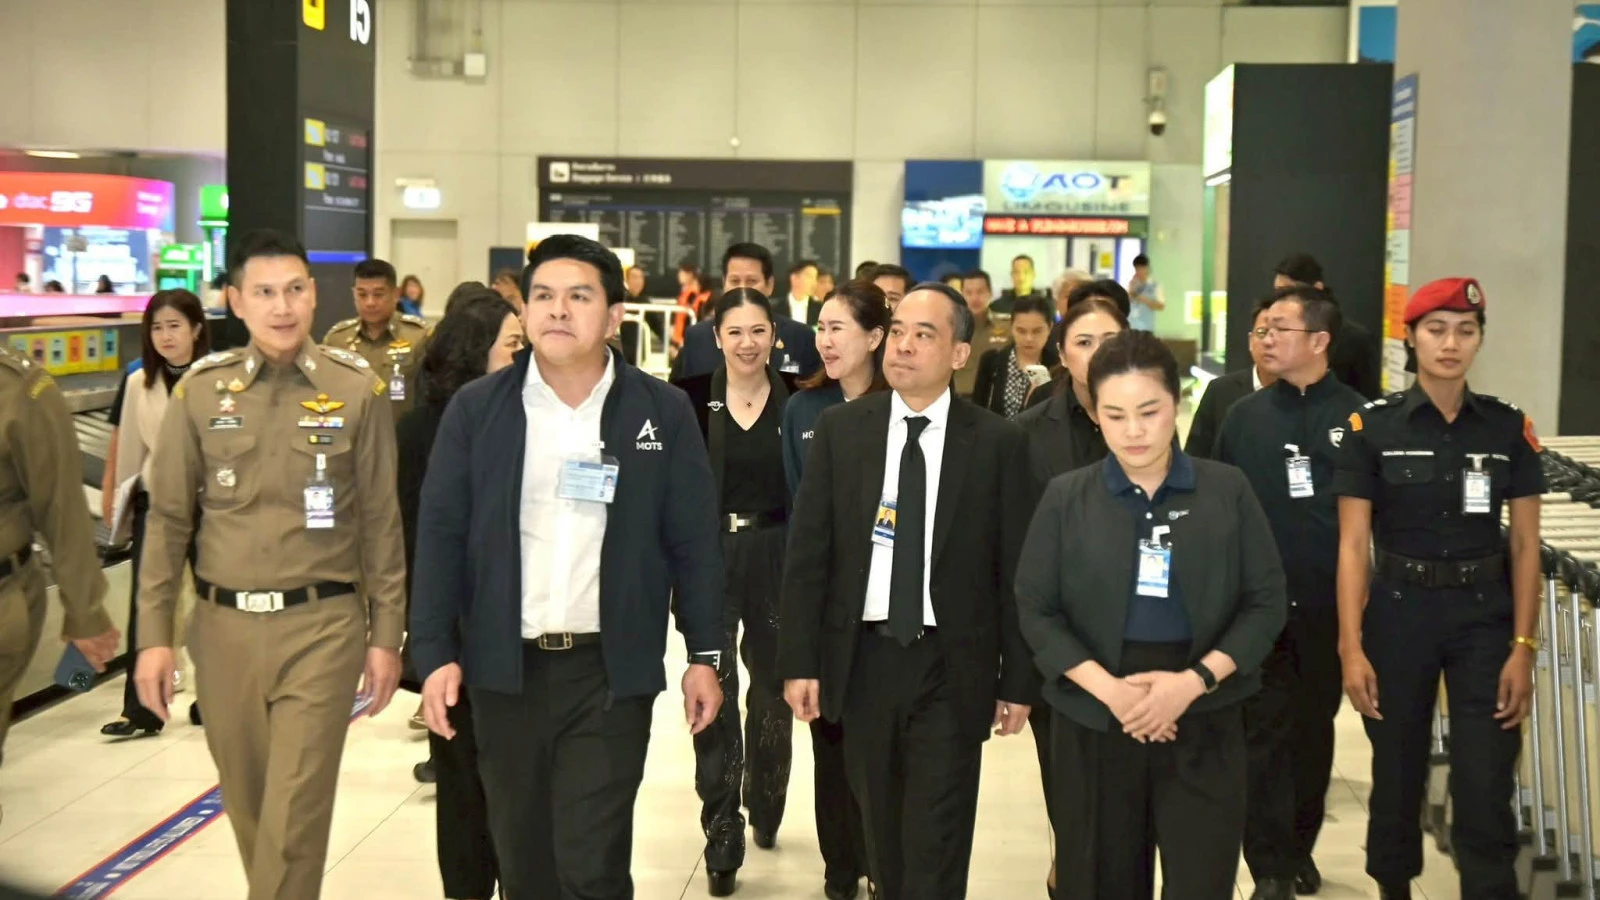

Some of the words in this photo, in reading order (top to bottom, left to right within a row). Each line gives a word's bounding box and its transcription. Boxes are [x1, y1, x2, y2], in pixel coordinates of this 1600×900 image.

[1042, 173, 1131, 189] AOT
[50, 191, 94, 213] 5G
[1003, 202, 1130, 212] LIMOUSINE
[635, 441, 663, 451] MOTS
